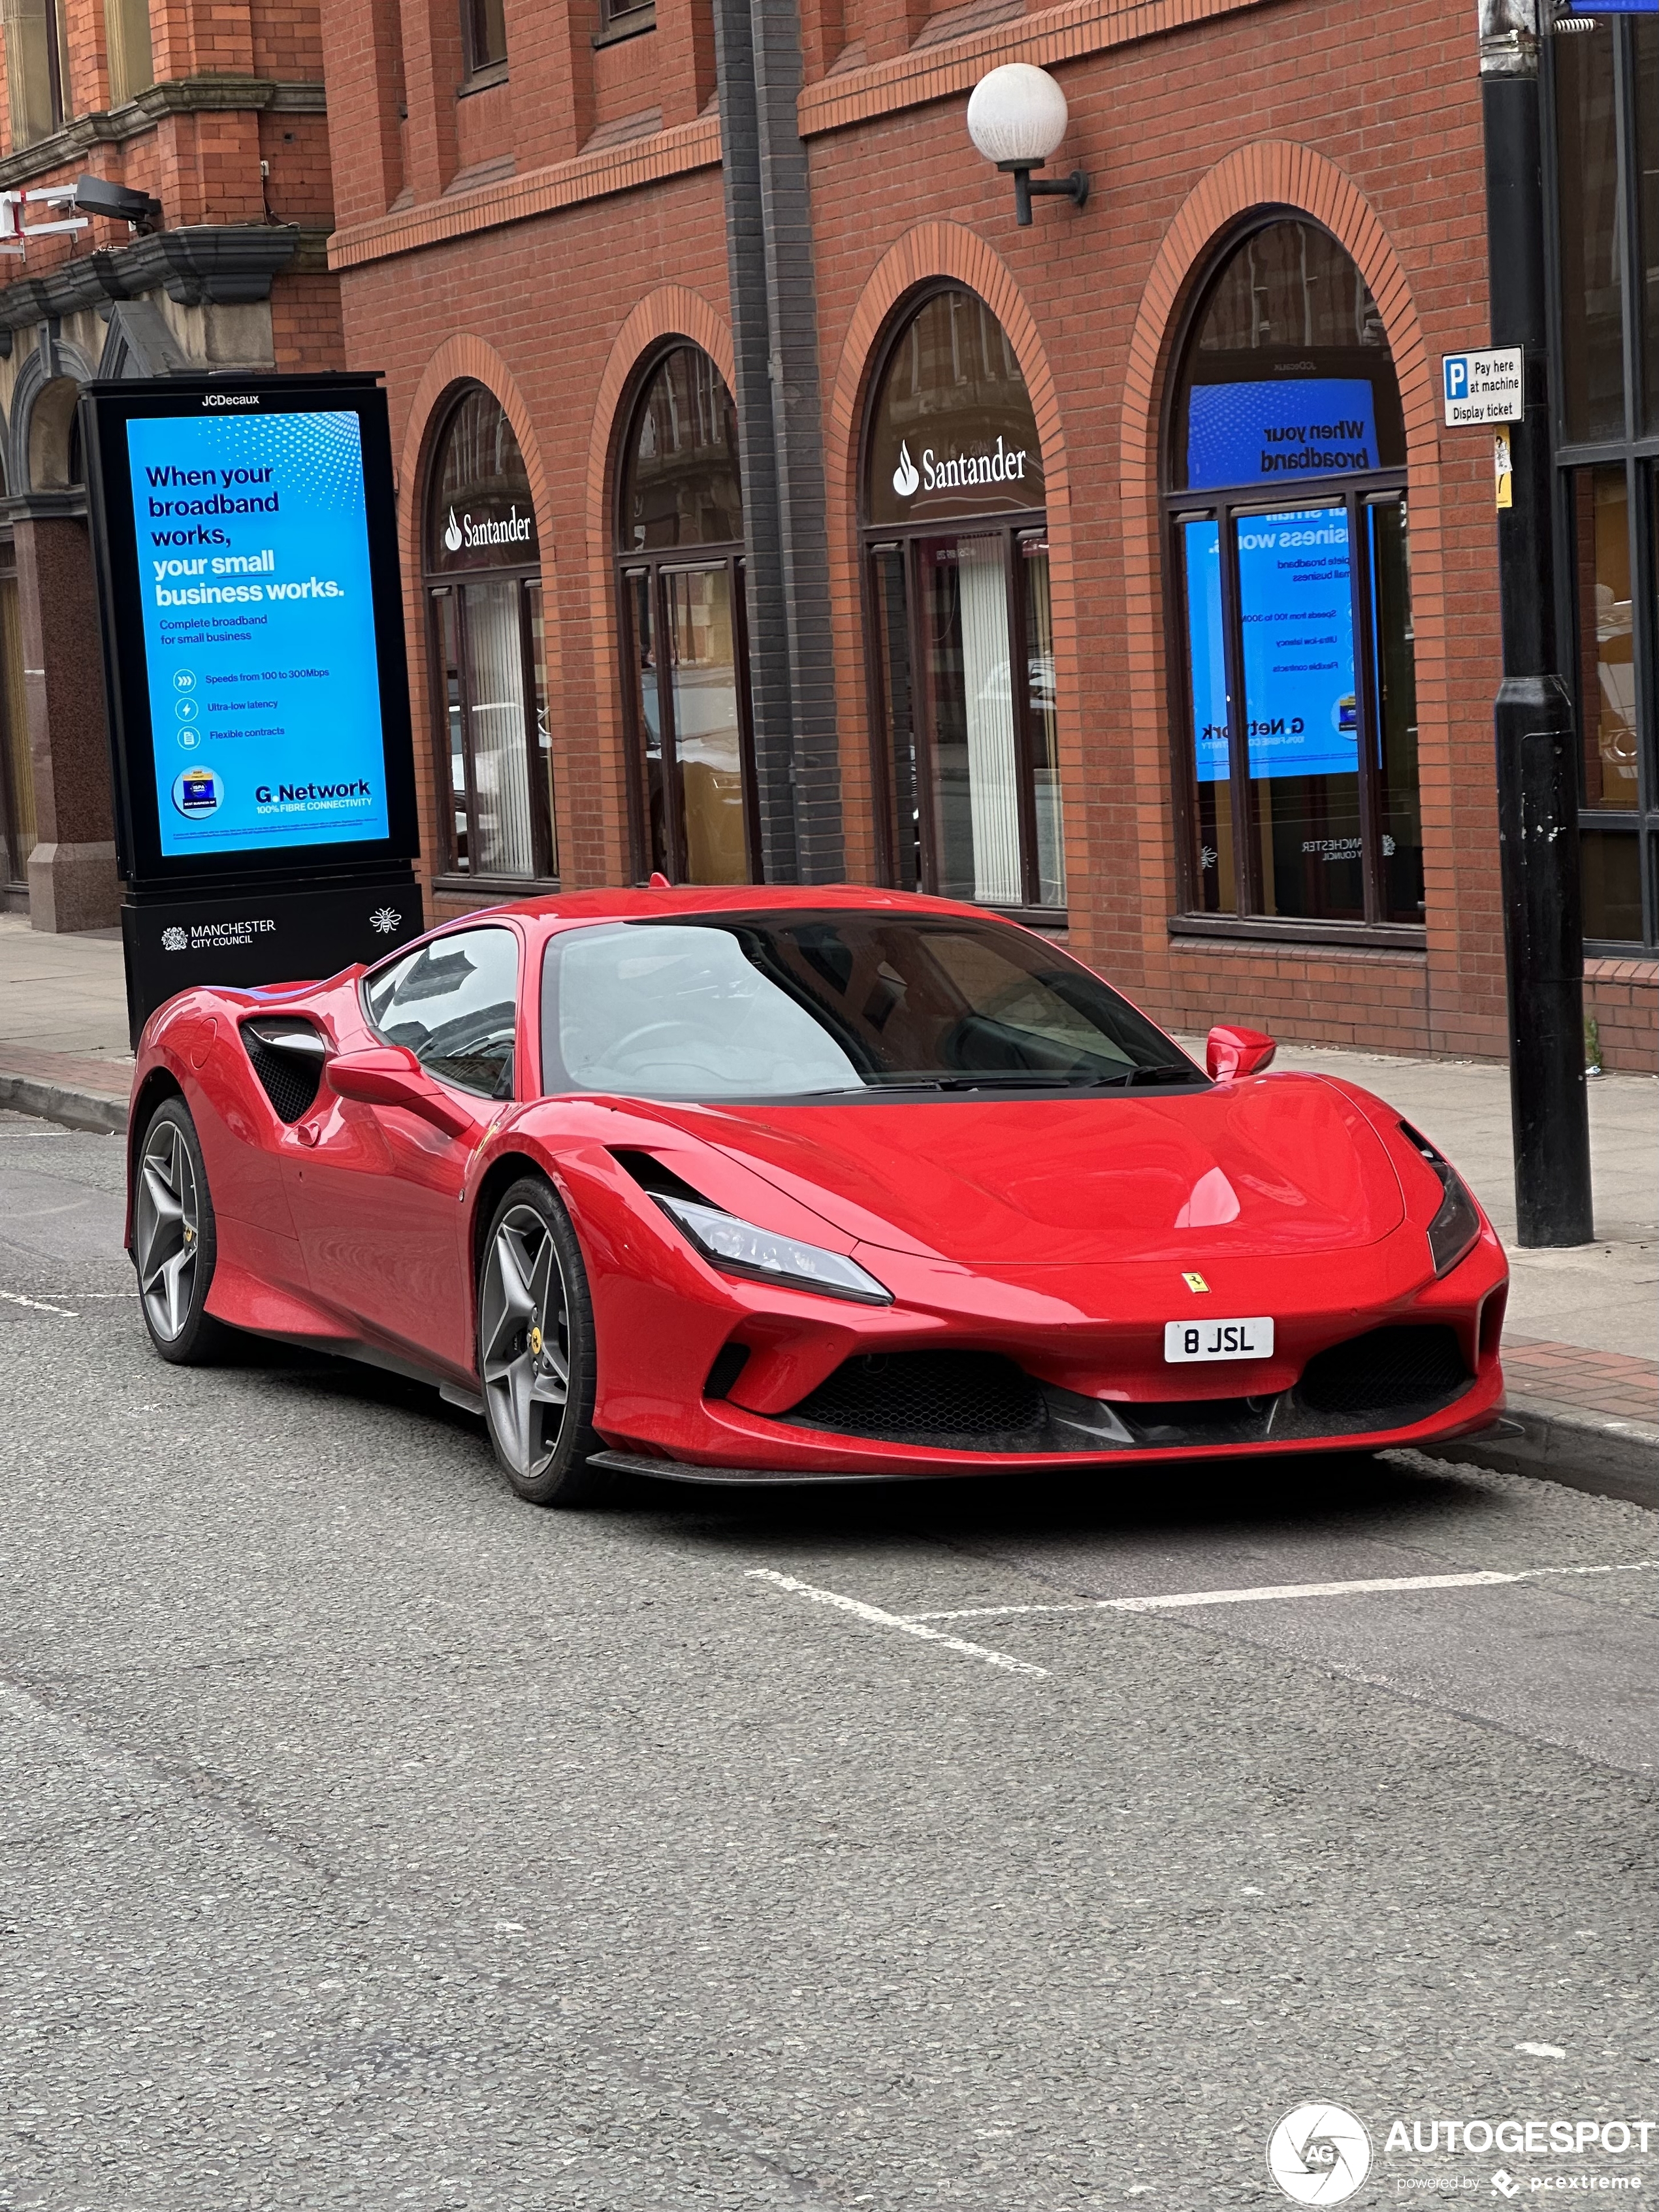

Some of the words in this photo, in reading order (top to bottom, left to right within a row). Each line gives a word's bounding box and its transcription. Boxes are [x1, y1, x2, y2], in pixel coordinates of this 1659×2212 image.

[1475, 362, 1490, 376] Pay
[1494, 360, 1513, 372] here
[1470, 381, 1479, 393] at
[1482, 377, 1519, 391] machine
[202, 395, 260, 406] JCDecaux
[1453, 405, 1484, 421] Display
[1487, 402, 1513, 417] ticket
[923, 435, 1026, 491] Santander
[146, 466, 216, 487] When
[221, 466, 274, 489] your
[148, 491, 280, 517] broadband
[464, 504, 530, 547] Santander
[150, 523, 232, 548] works,
[153, 557, 208, 581] your
[212, 549, 275, 574] small
[156, 583, 263, 606] business
[266, 576, 344, 600] works.
[159, 617, 210, 630] Complete
[212, 615, 268, 626] broadband
[161, 635, 176, 645] for
[177, 632, 205, 643] small
[206, 631, 252, 642] business
[206, 673, 238, 685] Speeds
[240, 672, 260, 682] from
[261, 670, 277, 681] 100
[278, 670, 287, 679] to
[288, 668, 330, 679] 300Mbps
[207, 702, 246, 712] Ultra-low
[248, 699, 278, 711] latency
[210, 729, 243, 740] Flexible
[244, 726, 285, 738] contracts
[256, 804, 280, 815] 100%
[280, 803, 306, 813] FIBRE
[307, 798, 372, 811] CONNECTIVITY
[191, 920, 276, 937] MANCHESTER
[191, 938, 212, 949] CITY
[214, 935, 253, 947] COUNCIL
[1185, 1329, 1199, 1354] 8
[1207, 1326, 1255, 1353] JSL
